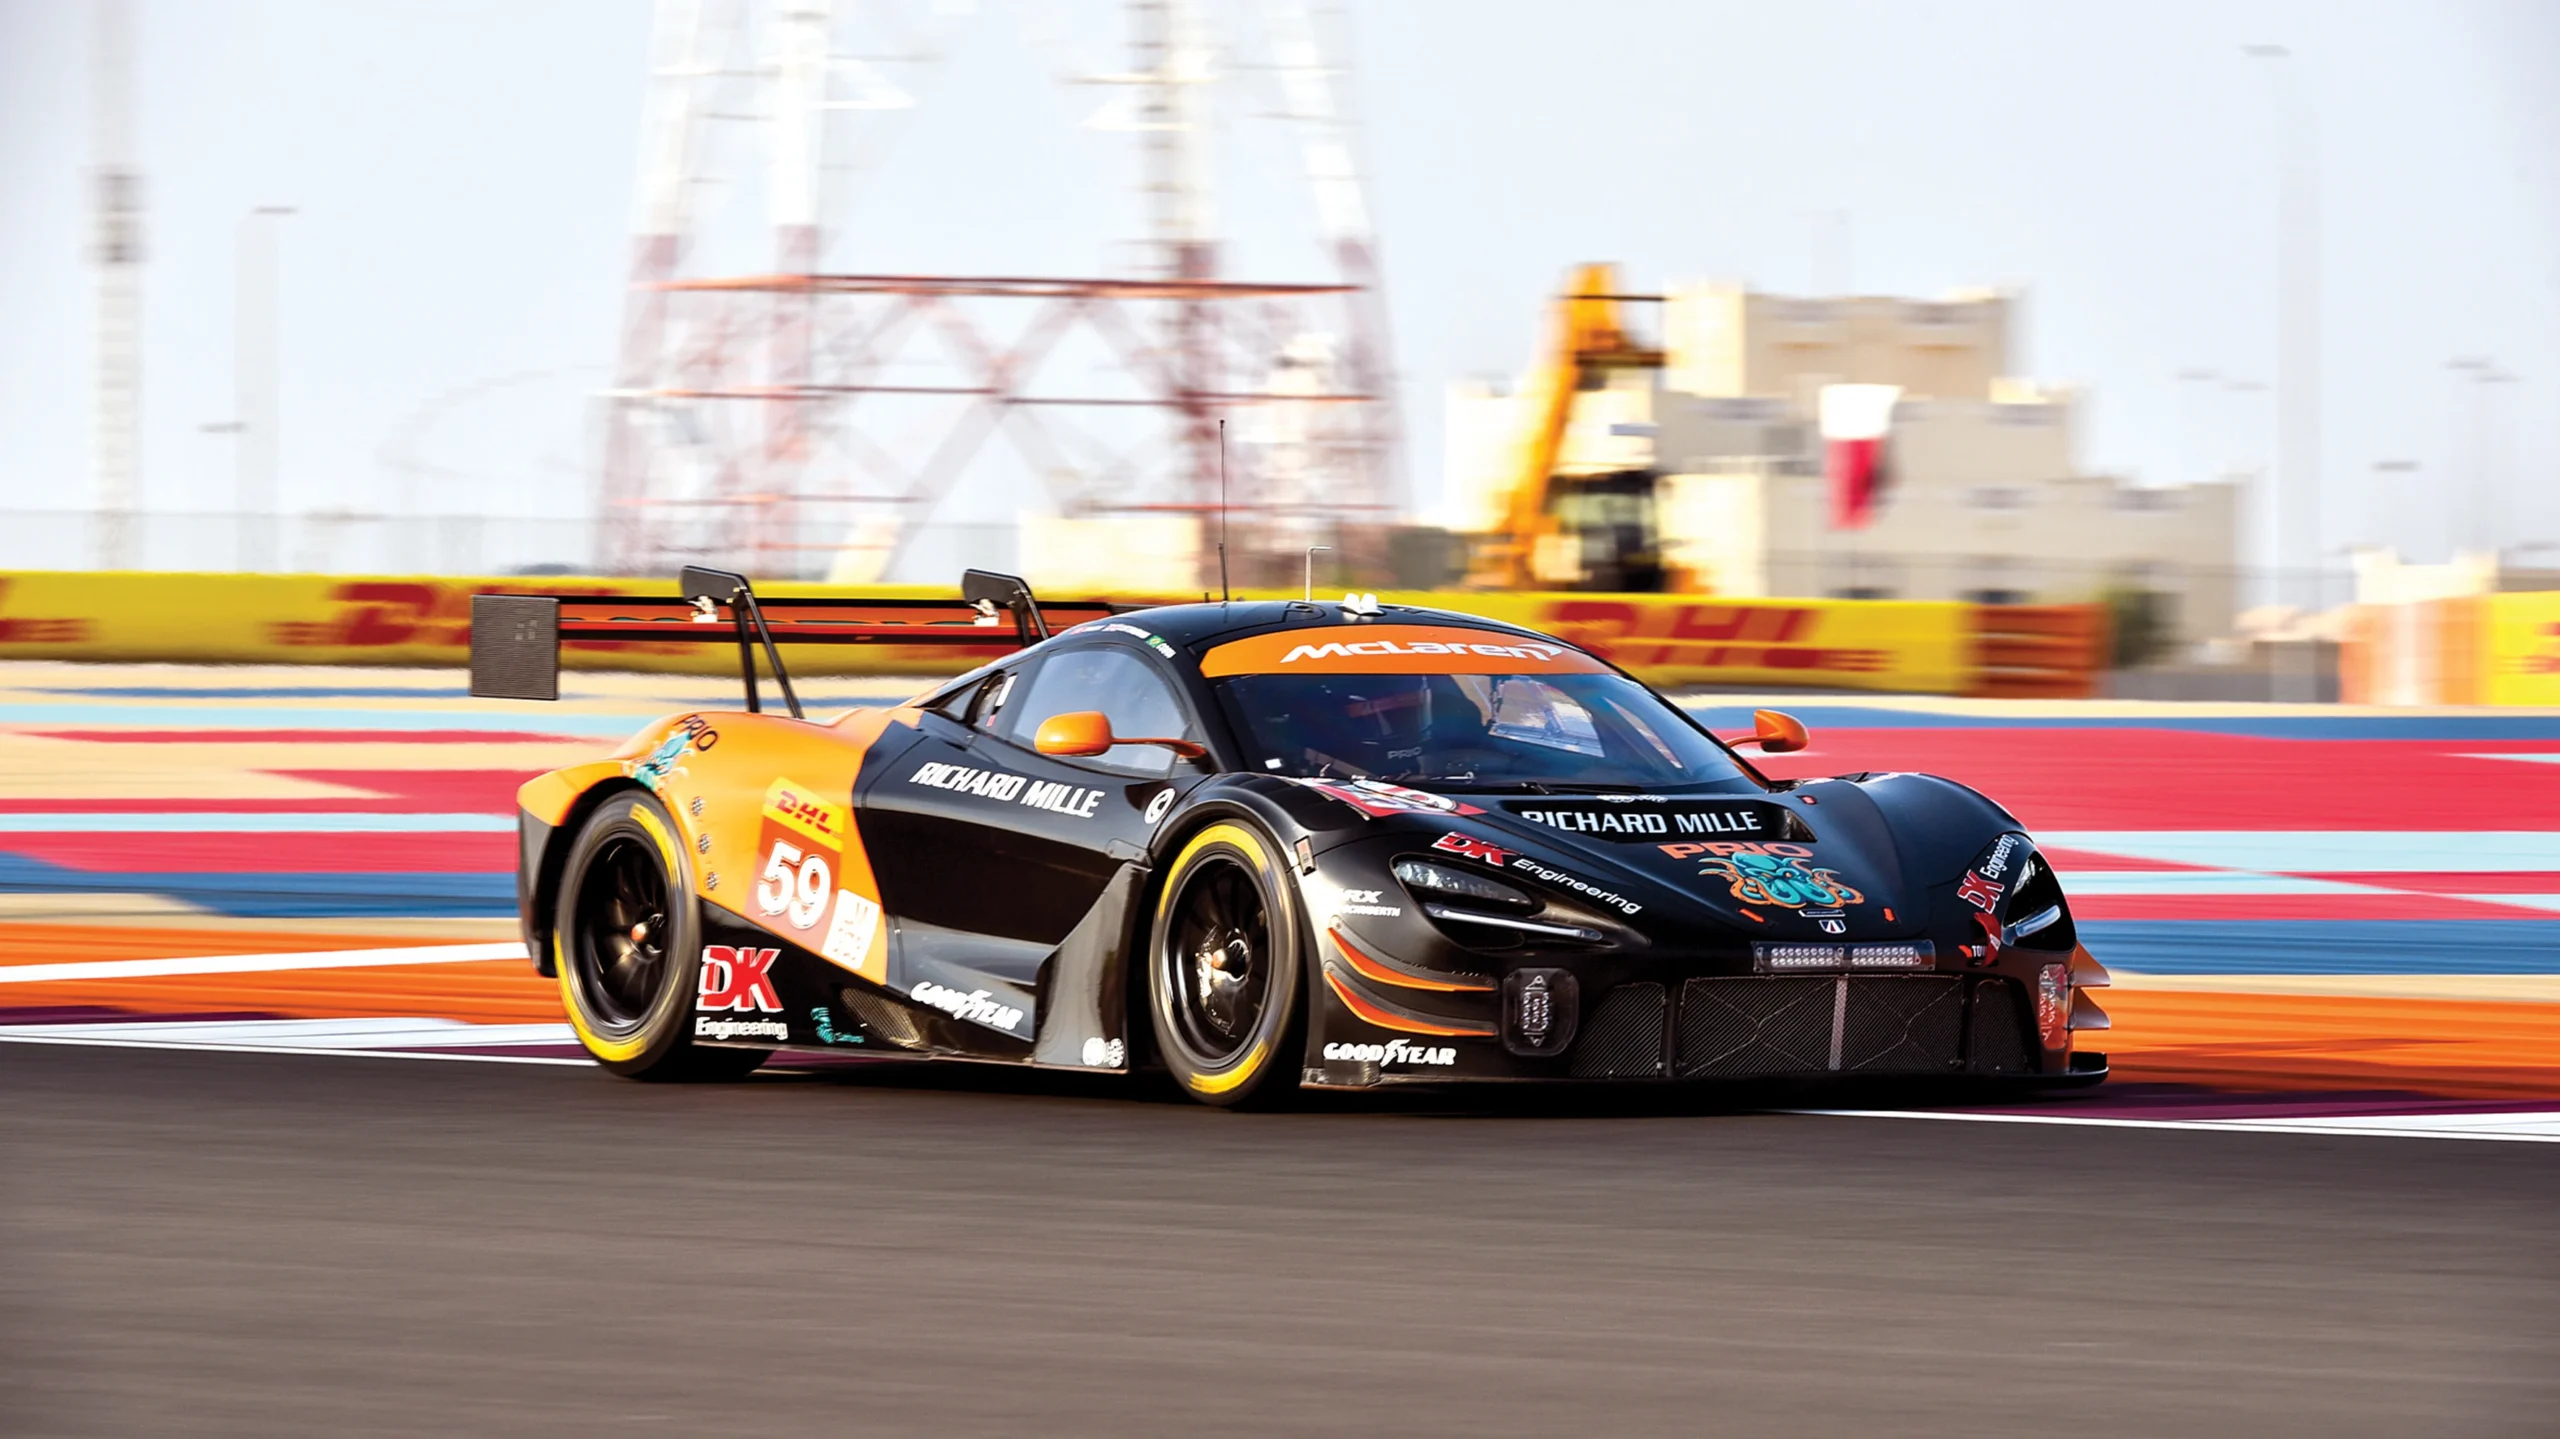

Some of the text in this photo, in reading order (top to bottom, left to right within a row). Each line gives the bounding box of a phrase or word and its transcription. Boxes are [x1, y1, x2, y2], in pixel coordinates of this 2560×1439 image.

[1280, 640, 1558, 663] McLaren
[672, 714, 718, 752] PRIO
[909, 762, 1106, 819] RICHARD MILLE
[776, 790, 832, 834] DHL
[1521, 811, 1762, 834] RICHARD MILLE
[1657, 842, 1814, 860] PRIO
[758, 838, 831, 930] 59
[1431, 838, 1643, 915] DK Engineering
[1957, 834, 2019, 915] DK Engineering
[696, 945, 785, 1013] DK
[695, 1016, 789, 1041] Engineering
[1323, 1038, 1457, 1068] GOODYEAR
